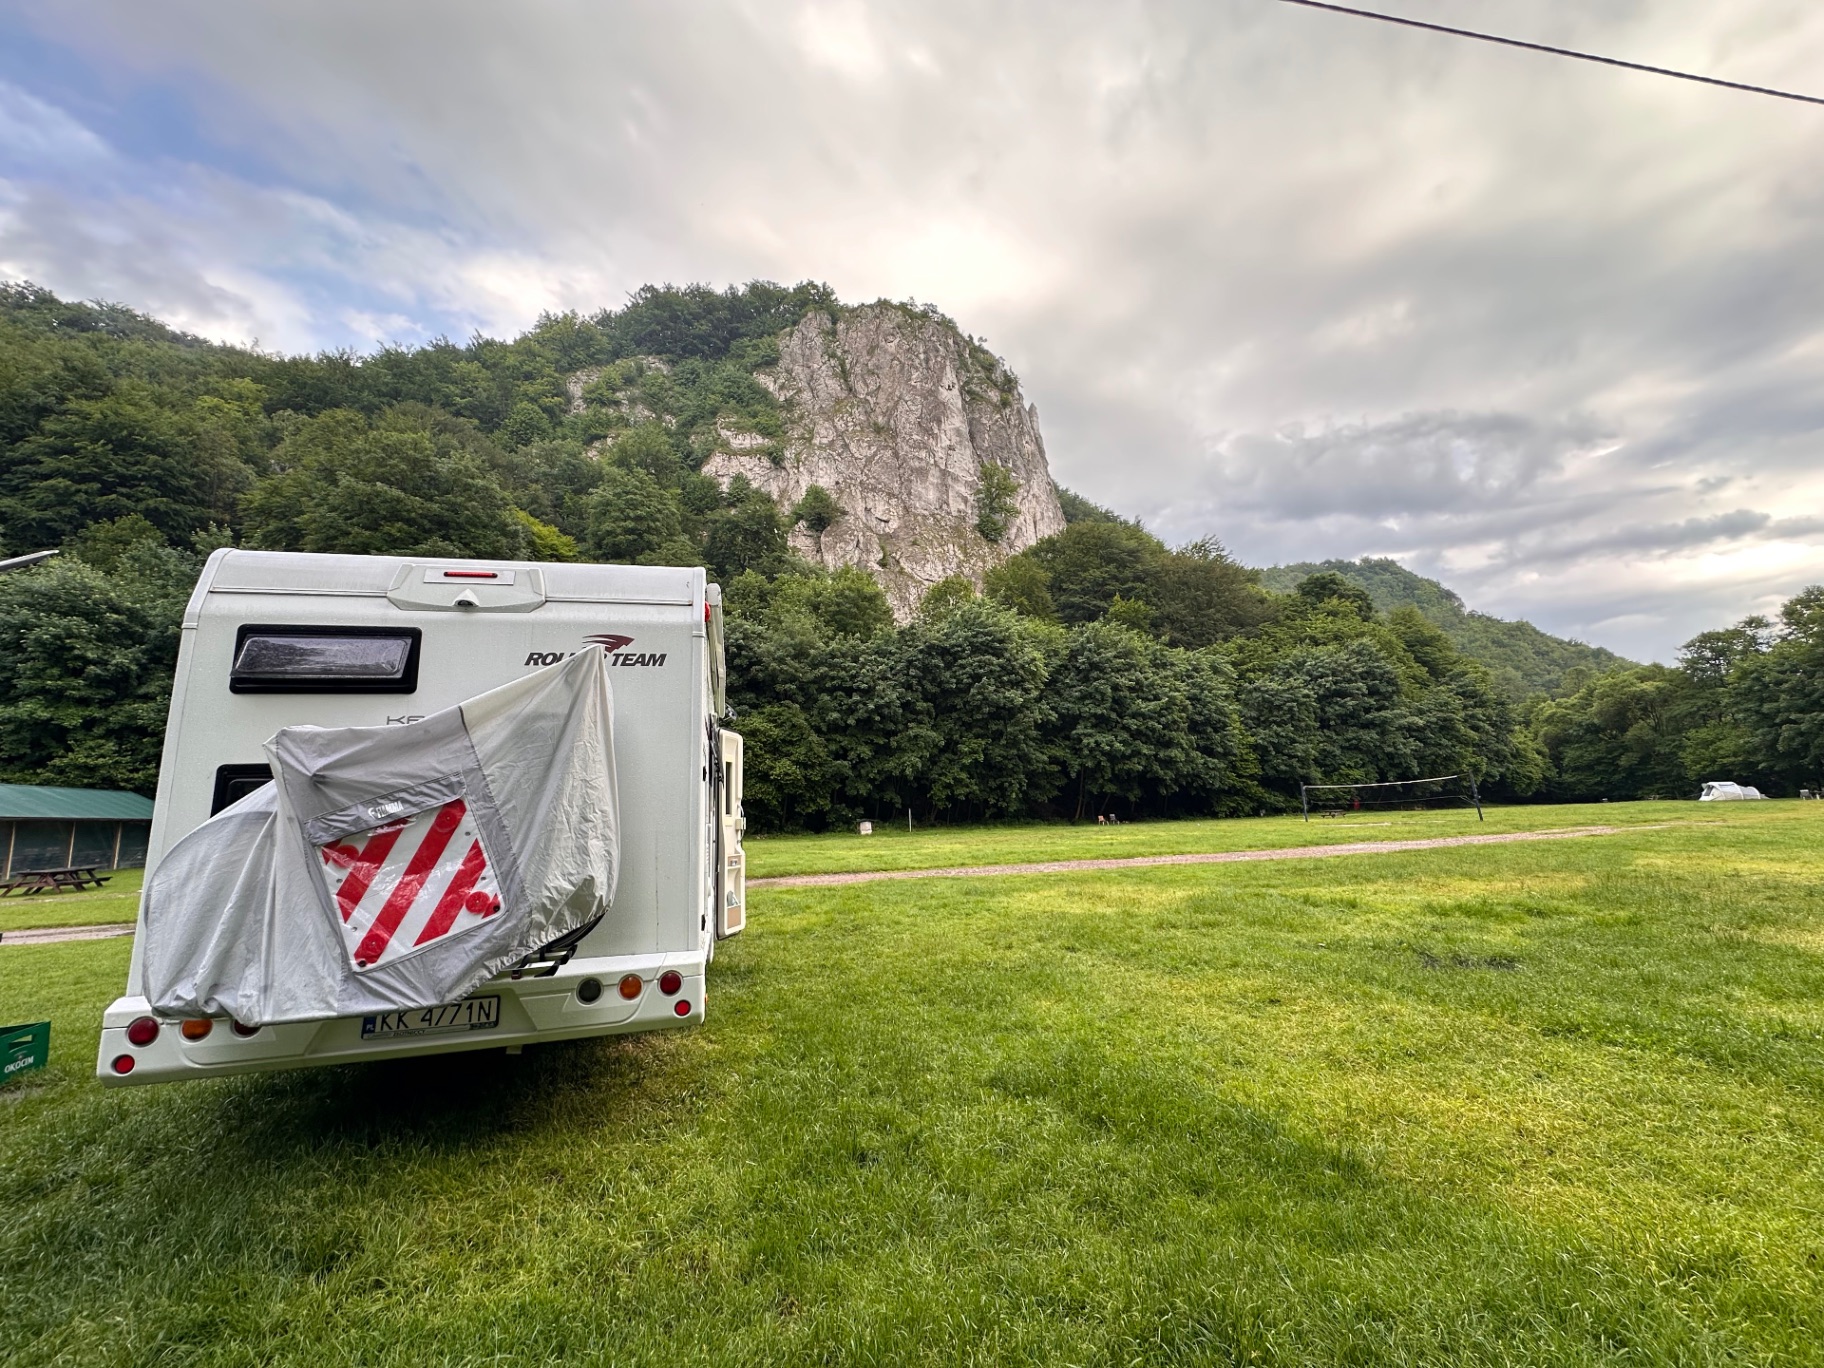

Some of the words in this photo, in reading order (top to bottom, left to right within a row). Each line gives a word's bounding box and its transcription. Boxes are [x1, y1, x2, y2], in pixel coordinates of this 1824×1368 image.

[524, 652, 608, 666] ROL
[611, 653, 667, 667] TEAM
[380, 1011, 409, 1031] KK
[420, 1001, 491, 1026] 4771N
[365, 1023, 375, 1031] PL
[4, 1055, 34, 1073] OKOCIM
